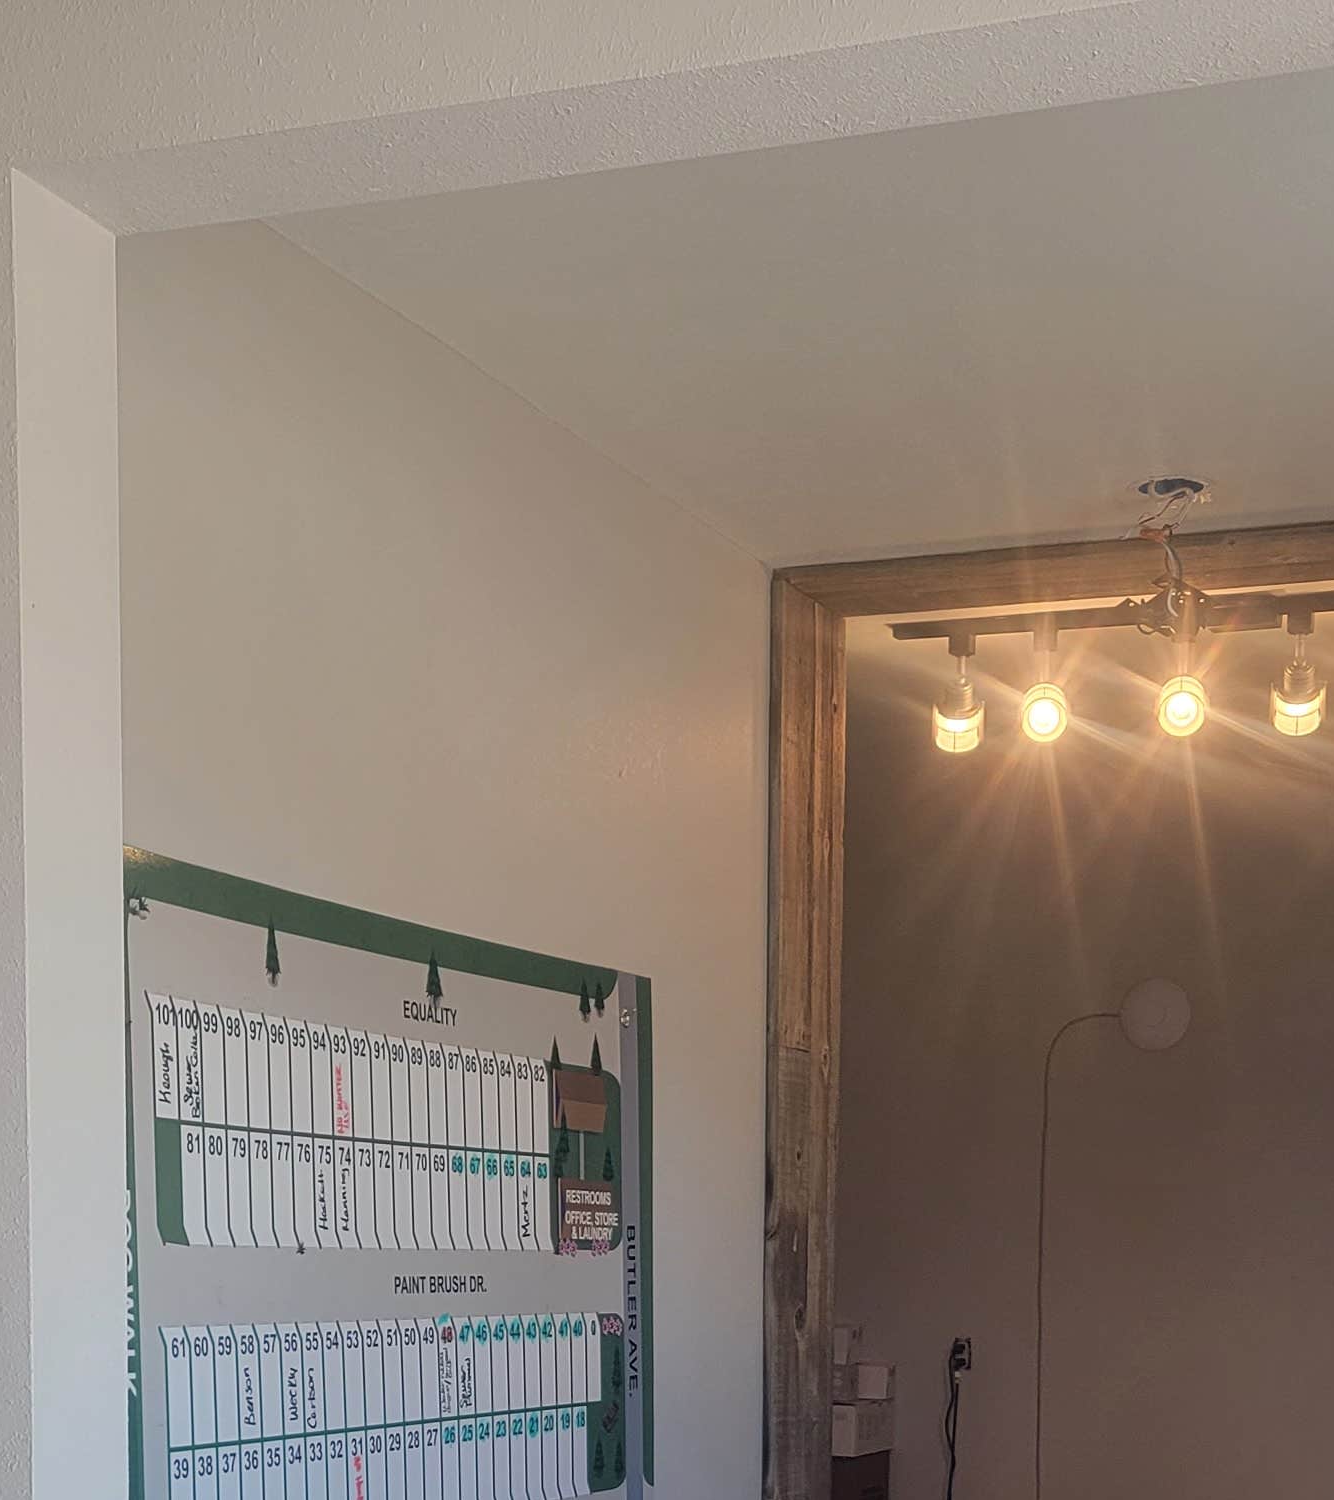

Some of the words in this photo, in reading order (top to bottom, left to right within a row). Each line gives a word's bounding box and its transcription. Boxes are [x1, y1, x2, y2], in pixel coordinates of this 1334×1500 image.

[403, 1000, 457, 1027] EQUALITY
[156, 1003, 177, 1026] 101
[179, 1008, 198, 1029] 100
[203, 1013, 217, 1033] 99
[227, 1016, 240, 1037] 98
[250, 1021, 263, 1040] 97
[271, 1024, 284, 1044] 96
[292, 1028, 305, 1048] 95
[313, 1032, 326, 1050] 94
[333, 1034, 346, 1054] 93
[353, 1038, 366, 1056] 92
[373, 1041, 386, 1060] 91
[392, 1044, 403, 1062] 90
[411, 1047, 423, 1066] 89
[429, 1050, 441, 1068] 88
[448, 1052, 459, 1071] 87
[465, 1055, 477, 1073] 86
[483, 1058, 494, 1075] 85
[500, 1060, 511, 1078] 84
[517, 1062, 528, 1080] 83
[534, 1065, 545, 1082] 82
[187, 1133, 200, 1154] 81
[209, 1135, 222, 1156] 80
[232, 1137, 246, 1158] 79
[255, 1140, 268, 1160] 78
[277, 1142, 290, 1161] 77
[297, 1144, 310, 1163] 76
[318, 1146, 331, 1164] 75
[339, 1147, 351, 1166] 74
[359, 1149, 371, 1167] 73
[379, 1150, 389, 1169] 72
[398, 1152, 409, 1170] 71
[416, 1153, 427, 1171] 70
[434, 1155, 445, 1172] 69
[451, 1156, 463, 1174] 68
[470, 1157, 480, 1175] 67
[486, 1158, 497, 1176] 66
[504, 1160, 514, 1176] 65
[521, 1162, 531, 1178] 64
[565, 1189, 611, 1206] RESTROOMS
[571, 1229, 578, 1239] &
[579, 1226, 613, 1241] LAUNDRY
[595, 1213, 618, 1226] STORE
[394, 1276, 426, 1294] PAINT
[429, 1275, 466, 1294] BRUSH
[470, 1275, 487, 1293] DR.
[627, 1225, 637, 1331] BUTLER
[171, 1337, 185, 1358] 61
[194, 1336, 209, 1357] 60
[218, 1336, 231, 1356] 59
[241, 1335, 254, 1354] 58
[263, 1334, 276, 1353] 57
[284, 1333, 297, 1352] 56
[305, 1332, 318, 1350] 55
[326, 1331, 339, 1350] 54
[347, 1330, 359, 1349] 53
[366, 1330, 378, 1347] 52
[387, 1329, 398, 1347] 51
[404, 1327, 416, 1346] 50
[423, 1326, 434, 1344] 49
[459, 1324, 470, 1342] 47
[476, 1323, 487, 1341] 46
[493, 1323, 504, 1340] 45
[510, 1322, 521, 1339] 44
[526, 1321, 537, 1339] 43
[542, 1320, 553, 1338] 42
[559, 1320, 569, 1336] 41
[573, 1320, 583, 1336] 40
[629, 1338, 639, 1398] AVE.
[174, 1458, 189, 1479] 39
[198, 1456, 213, 1476] 38
[222, 1453, 236, 1473] 37
[244, 1451, 258, 1470] 36
[267, 1448, 281, 1467] 35
[288, 1445, 302, 1464] 34
[310, 1443, 323, 1462] 33
[330, 1440, 343, 1459] 32
[351, 1438, 363, 1456] 31
[369, 1434, 382, 1454] 30
[389, 1433, 401, 1451] 29
[408, 1431, 420, 1449] 28
[427, 1429, 438, 1447] 27
[444, 1427, 456, 1444] 26
[462, 1424, 473, 1442] 25
[479, 1423, 490, 1440] 24
[496, 1421, 507, 1438] 23
[513, 1419, 523, 1436] 22
[529, 1416, 539, 1434] 21
[544, 1415, 554, 1432] 20
[561, 1412, 571, 1429] 19
[576, 1411, 585, 1427] 18
